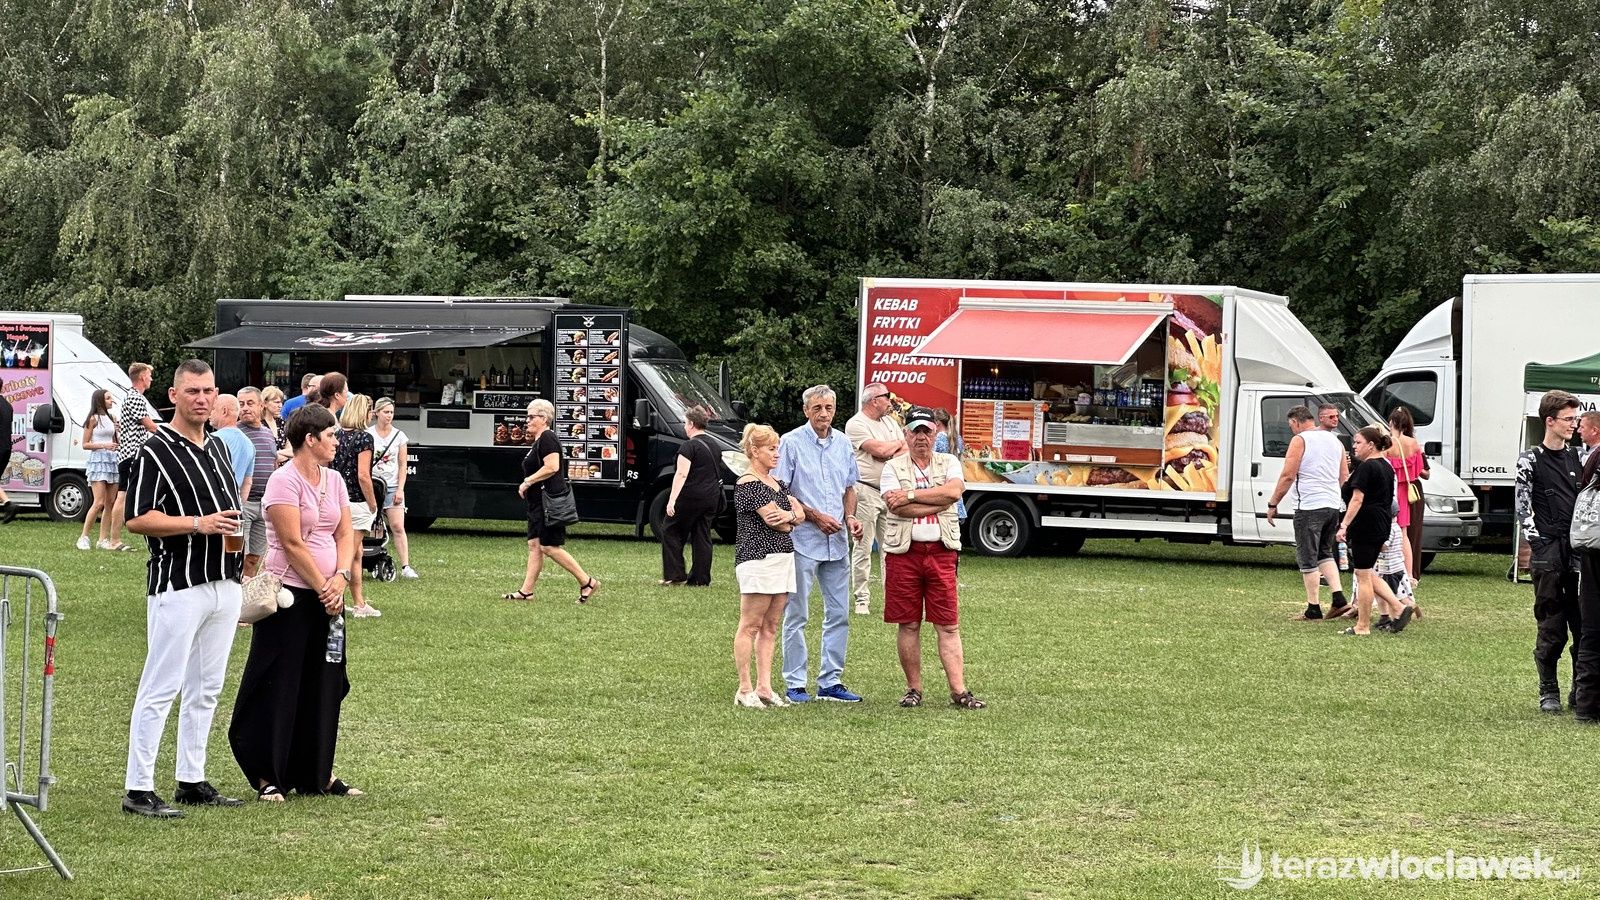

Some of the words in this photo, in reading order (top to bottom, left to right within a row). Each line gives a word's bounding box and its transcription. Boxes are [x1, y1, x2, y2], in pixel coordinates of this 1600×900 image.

[874, 298, 919, 311] KEBAB
[873, 316, 921, 329] FRYTKI
[871, 352, 955, 367] ZAPIEKANKA
[871, 370, 927, 384] HOTDOG
[1579, 401, 1597, 411] NA
[627, 469, 639, 480] RS
